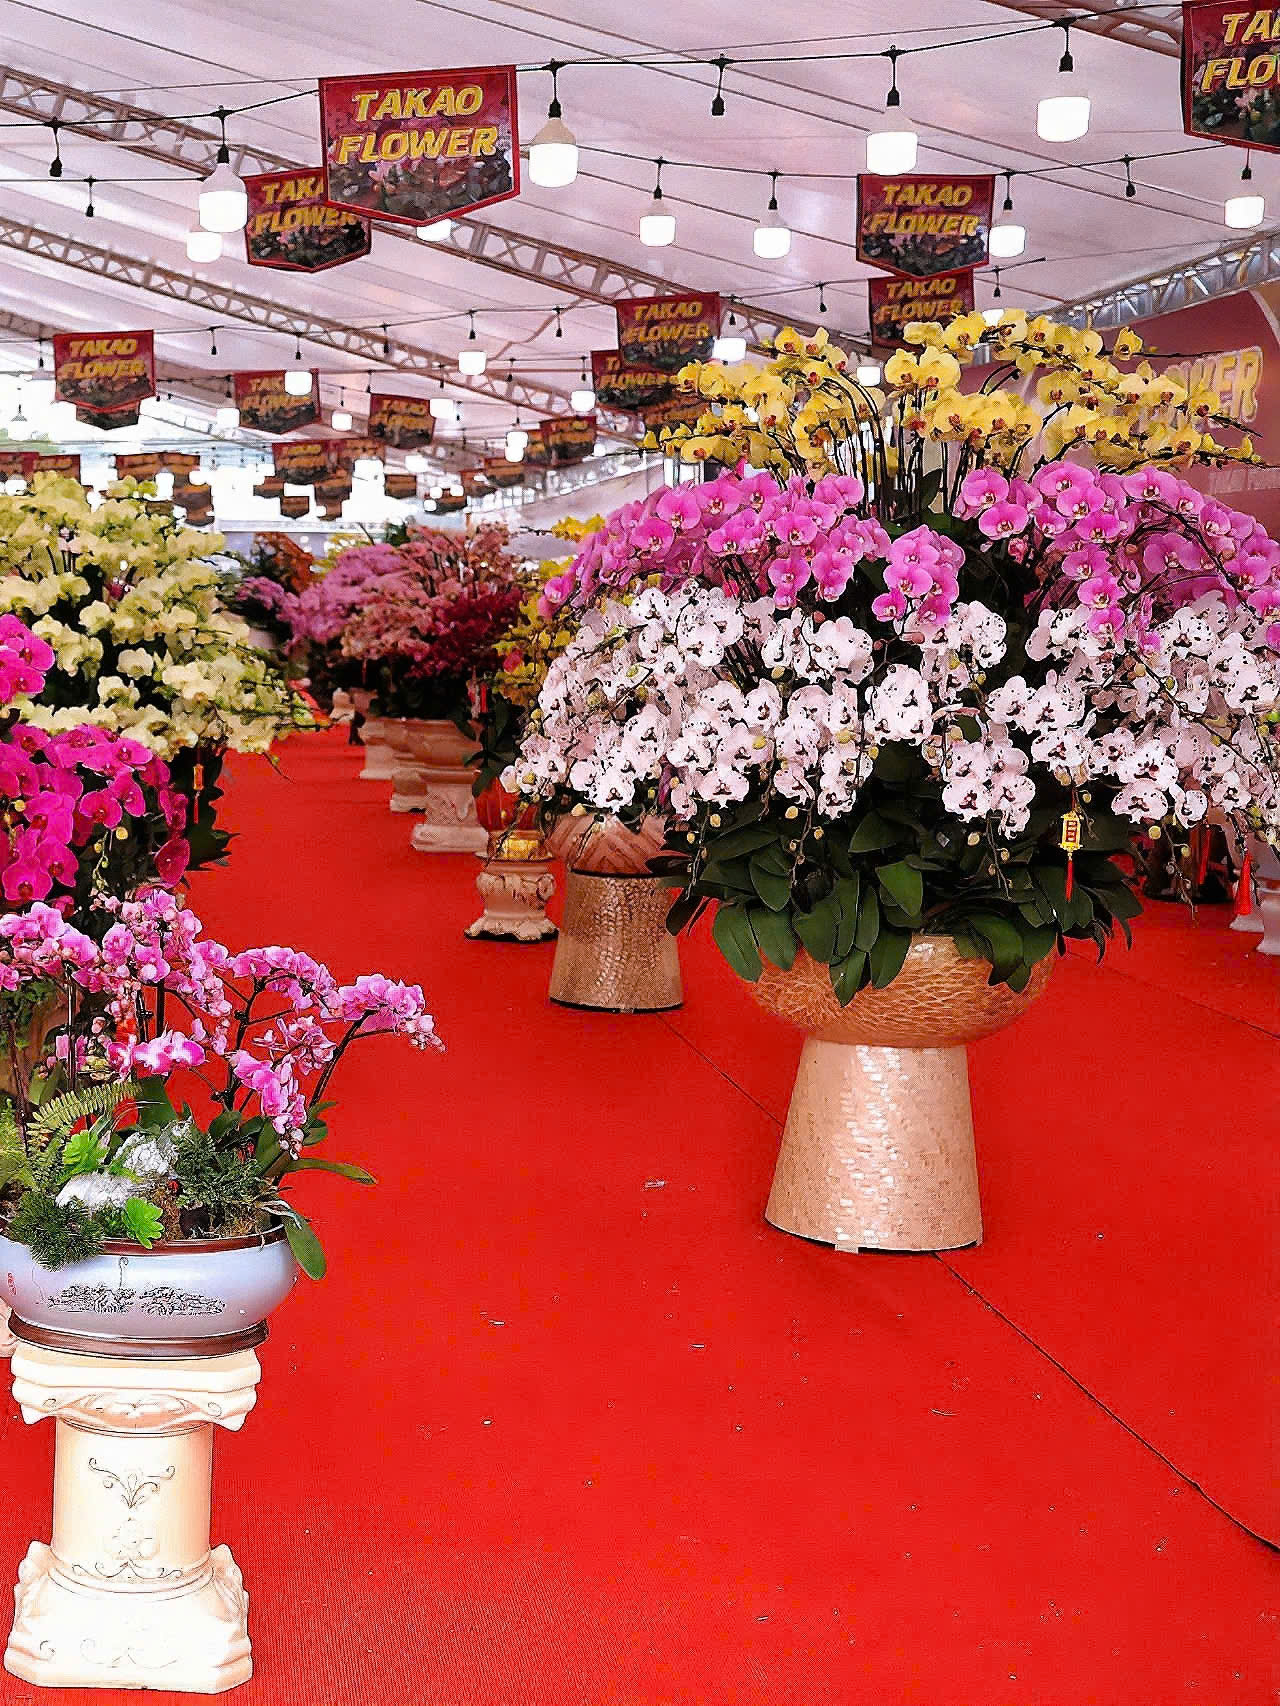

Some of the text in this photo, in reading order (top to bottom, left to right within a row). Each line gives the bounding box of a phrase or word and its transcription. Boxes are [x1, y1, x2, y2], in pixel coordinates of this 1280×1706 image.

[1222, 10, 1280, 46] TA
[1200, 53, 1280, 93] FLO
[352, 85, 483, 122] TAKAO
[336, 126, 498, 165] FLOWER
[882, 184, 973, 207] TAKAO
[869, 214, 981, 236] FLOWER
[886, 278, 957, 300] TAKAO
[633, 302, 704, 321] TAKAO
[877, 299, 964, 322] FLOWER
[622, 323, 709, 344] FLOWER
[69, 338, 137, 359] TAKAO
[59, 359, 145, 380] FLOWER
